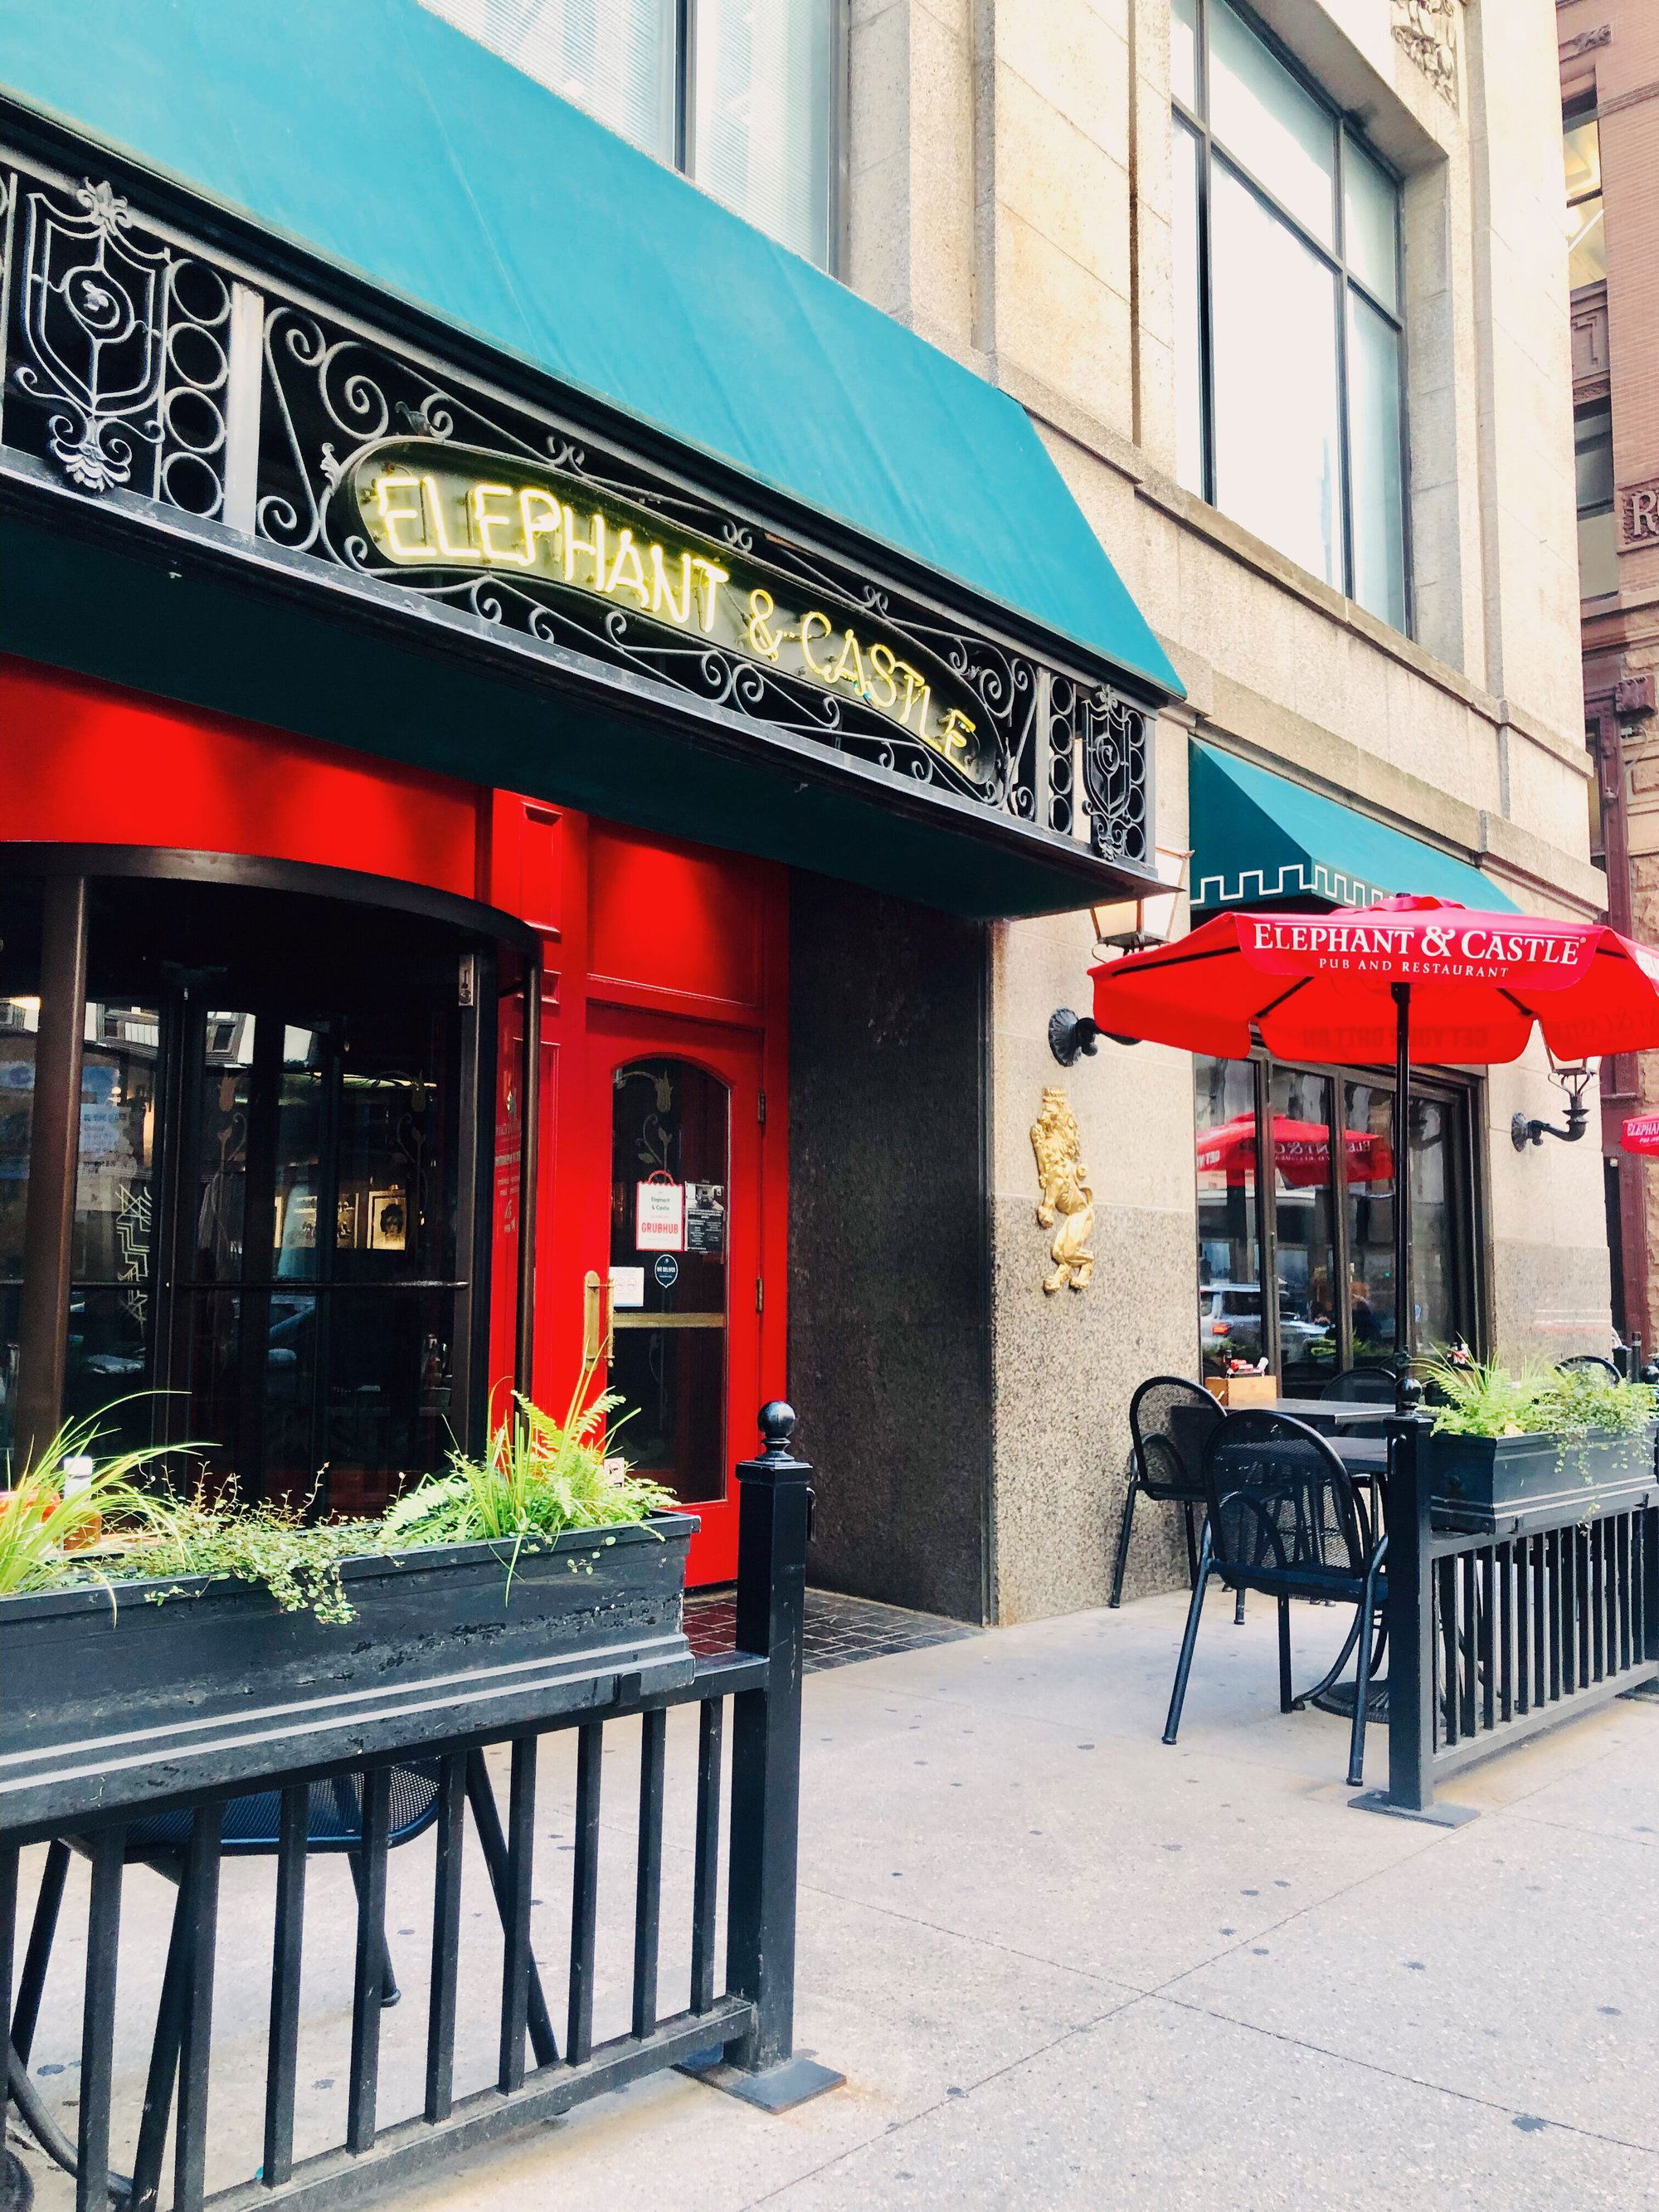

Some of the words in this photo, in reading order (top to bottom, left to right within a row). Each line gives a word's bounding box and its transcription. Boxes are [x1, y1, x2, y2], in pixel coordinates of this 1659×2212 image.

[376, 475, 730, 633] ELEPHANT
[748, 587, 783, 662] &
[800, 611, 977, 775] CASTLE
[1253, 923, 1414, 954] ELEPHANT
[1421, 925, 1456, 957] &
[1318, 957, 1350, 969] PUB
[1358, 959, 1392, 972] AND
[1401, 961, 1509, 978] RESTAURANT
[1627, 1122, 1659, 1137] ELEPHA
[641, 1222, 679, 1235] GRUBHUB
